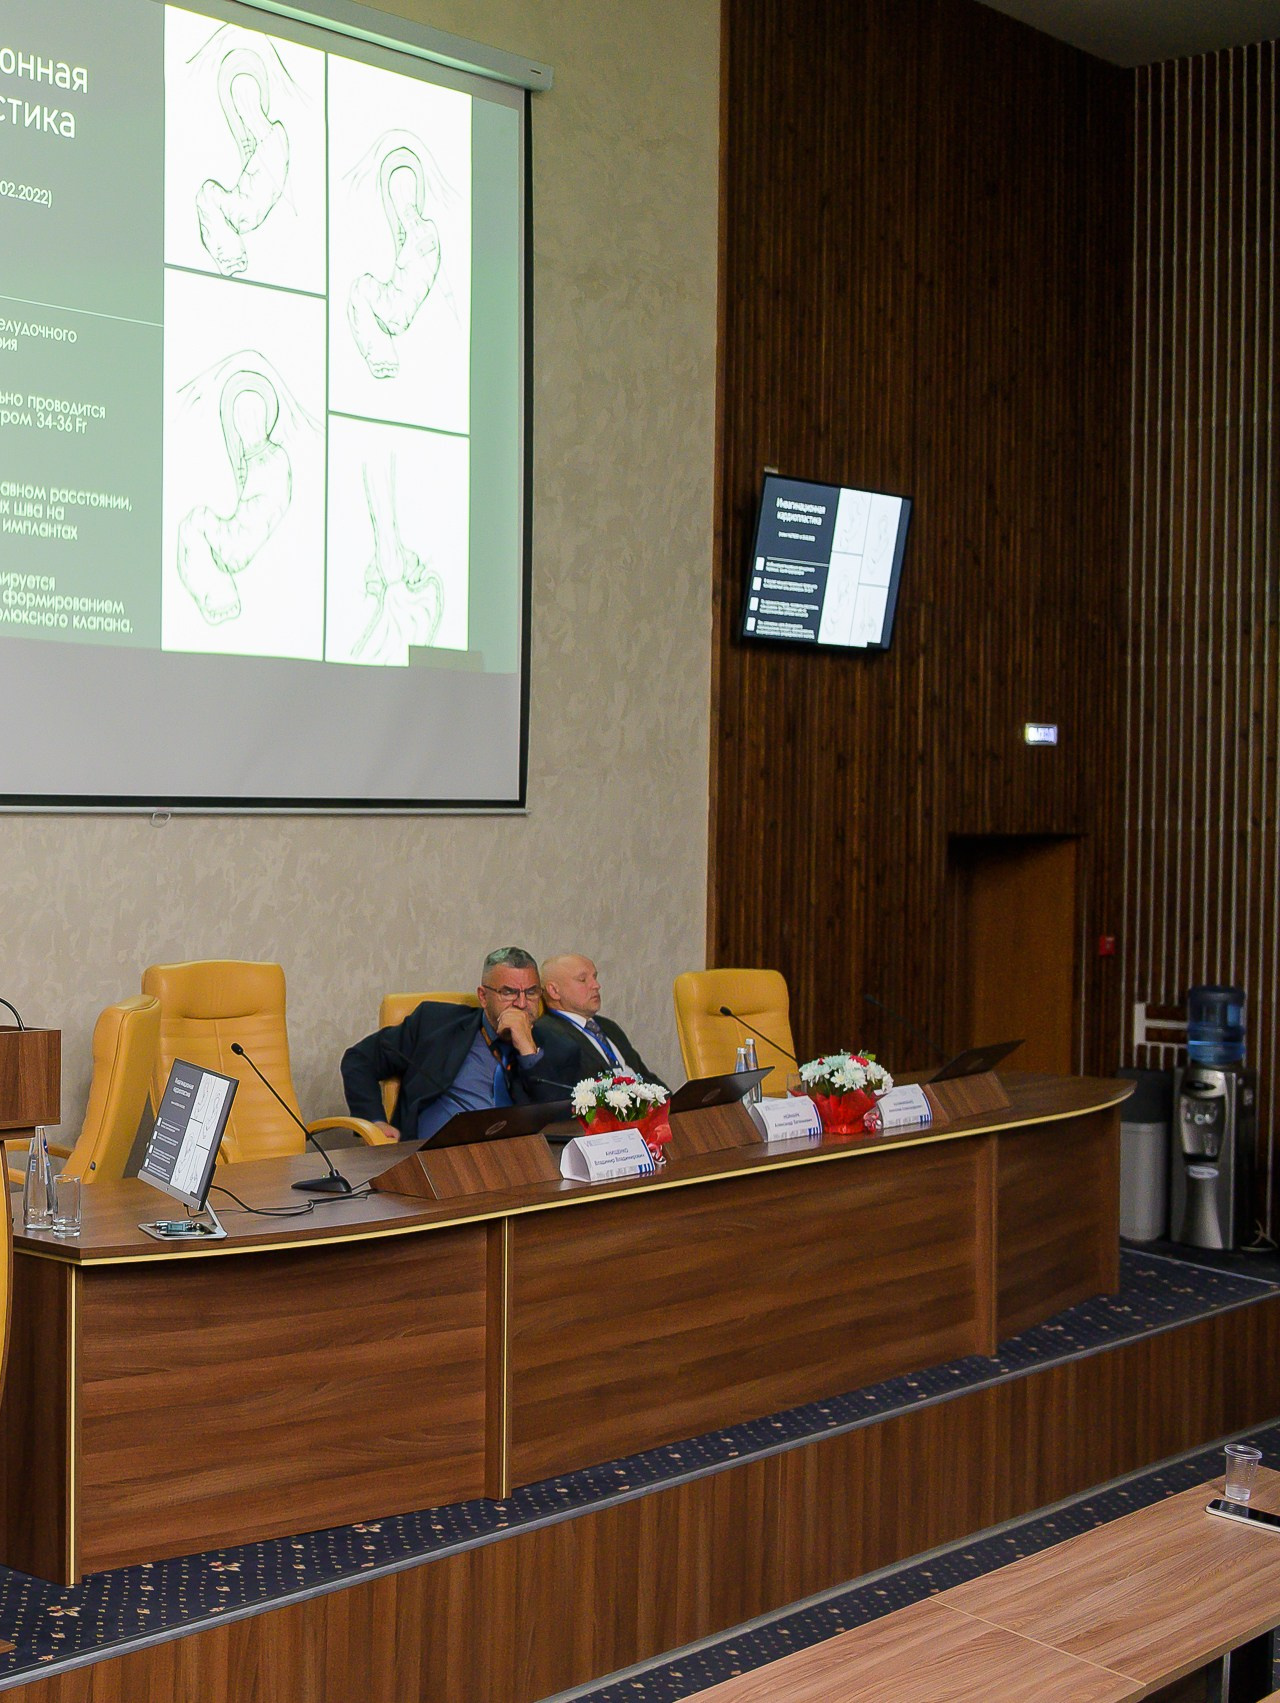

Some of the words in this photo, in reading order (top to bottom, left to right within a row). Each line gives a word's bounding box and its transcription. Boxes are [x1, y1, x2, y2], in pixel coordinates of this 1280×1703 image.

[27, 395, 106, 419] проводится
[36, 412, 73, 433] 34-36
[75, 417, 87, 434] Fr
[13, 500, 44, 519] шва
[46, 503, 65, 521] на
[49, 486, 133, 513] расстоянии,
[2, 516, 78, 541] имплантах
[2, 585, 125, 616] формированием
[72, 614, 134, 635] клапана.
